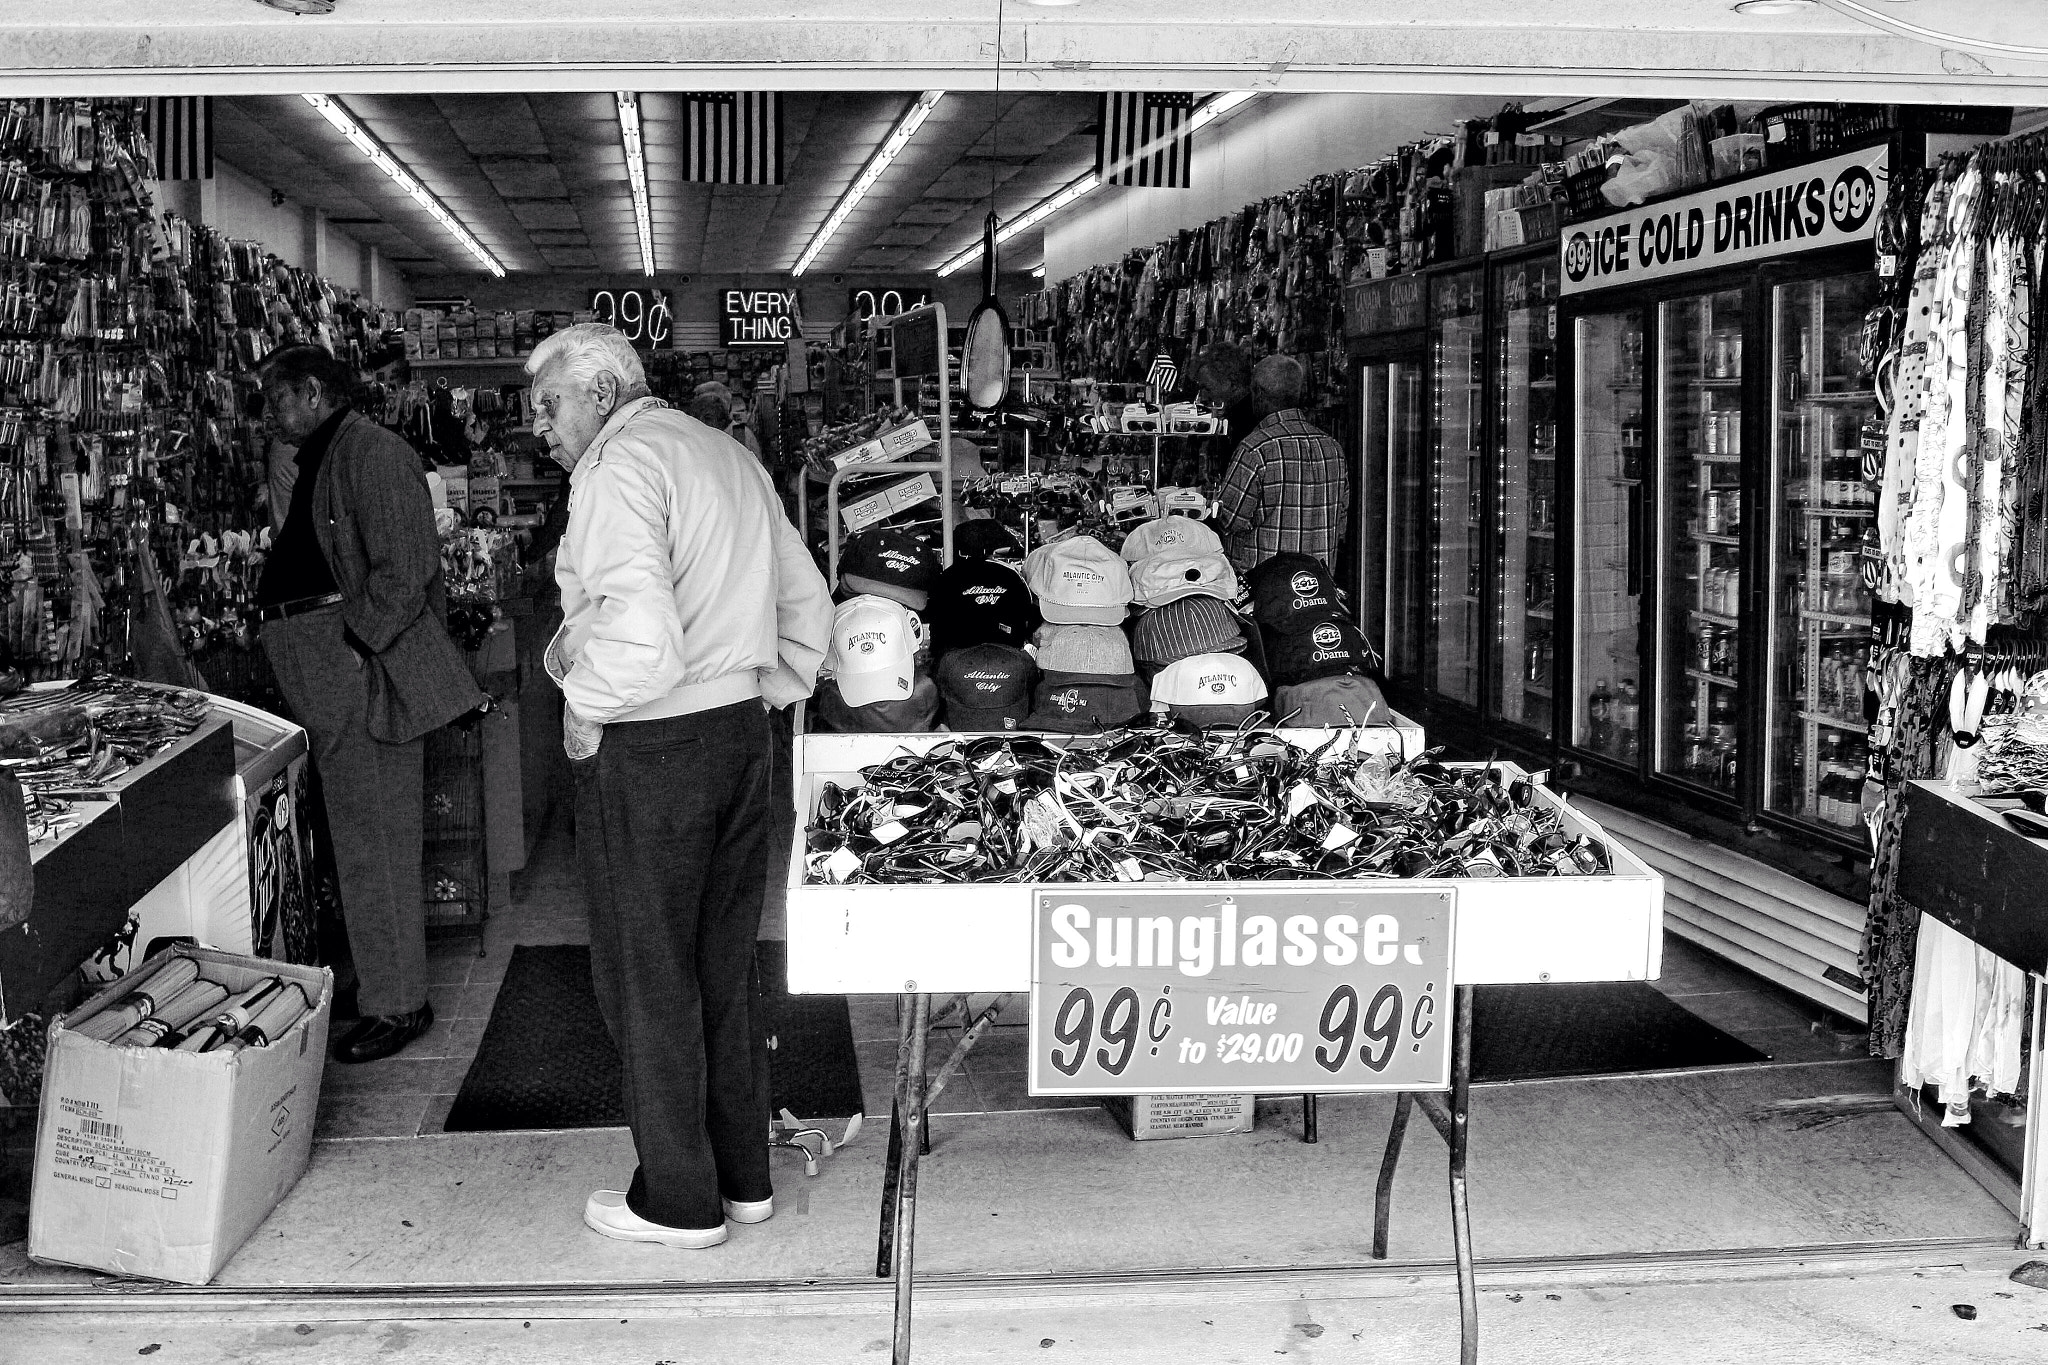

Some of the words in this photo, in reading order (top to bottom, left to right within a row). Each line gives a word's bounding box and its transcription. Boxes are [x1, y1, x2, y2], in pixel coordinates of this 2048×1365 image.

[1566, 239, 1591, 275] 99¢
[1593, 223, 1631, 277] ICE
[1639, 207, 1704, 268] COLD
[1714, 177, 1825, 254] DRINKS
[1832, 181, 1875, 223] 99¢
[727, 291, 795, 314] EVERY
[730, 317, 791, 339] THING
[1063, 571, 1091, 580] ATLANTIC
[1092, 573, 1105, 582] CITY
[1292, 597, 1328, 610] Obama
[847, 631, 887, 651] ATLANTIC
[1312, 649, 1351, 662] Obama
[964, 670, 1011, 680] Atlantic
[1198, 673, 1237, 690] ATLANTIC
[975, 681, 1002, 693] City
[1206, 995, 1277, 1026] Value
[1050, 984, 1172, 1077] 99¢
[1314, 982, 1434, 1074] 99¢
[1178, 1037, 1206, 1064] to
[1216, 1032, 1304, 1064] $29.00
[53, 1171, 78, 1182] GENERAL
